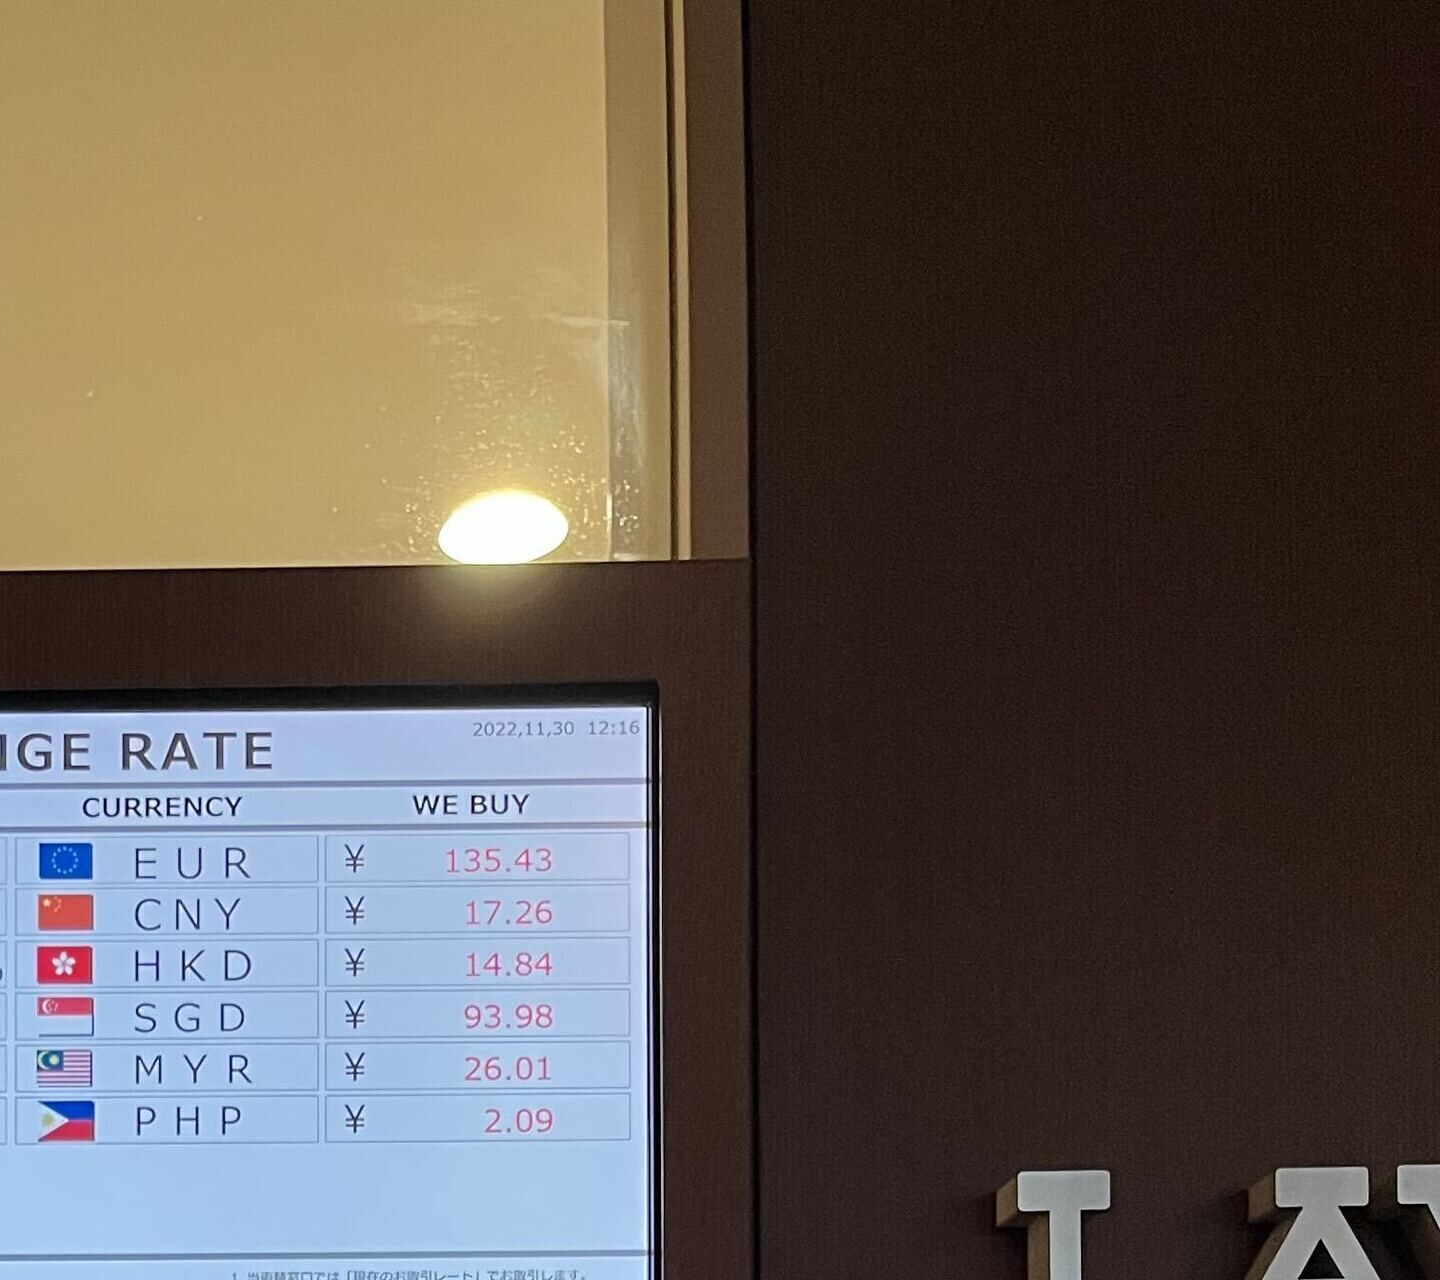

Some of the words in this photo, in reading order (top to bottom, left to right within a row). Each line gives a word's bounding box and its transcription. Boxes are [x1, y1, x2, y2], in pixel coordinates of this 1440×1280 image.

[472, 720, 575, 739] 2022,11,30
[587, 719, 641, 737] 12:16
[121, 731, 275, 771] RATE
[82, 796, 243, 818] CURRENCY
[413, 794, 458, 815] WE
[470, 793, 530, 814] BUY
[134, 847, 252, 880] EUR
[444, 847, 553, 873] 135.43
[134, 898, 242, 931] CNY
[465, 899, 553, 926] 17.26
[134, 949, 252, 982] HKD
[465, 952, 553, 977] 14.84
[134, 1002, 247, 1034] SGD
[463, 1004, 554, 1029] 93.98
[135, 1054, 253, 1085] MYR
[464, 1056, 552, 1081] 26.01
[136, 1106, 242, 1136] PHP
[484, 1108, 554, 1133] 2.09
